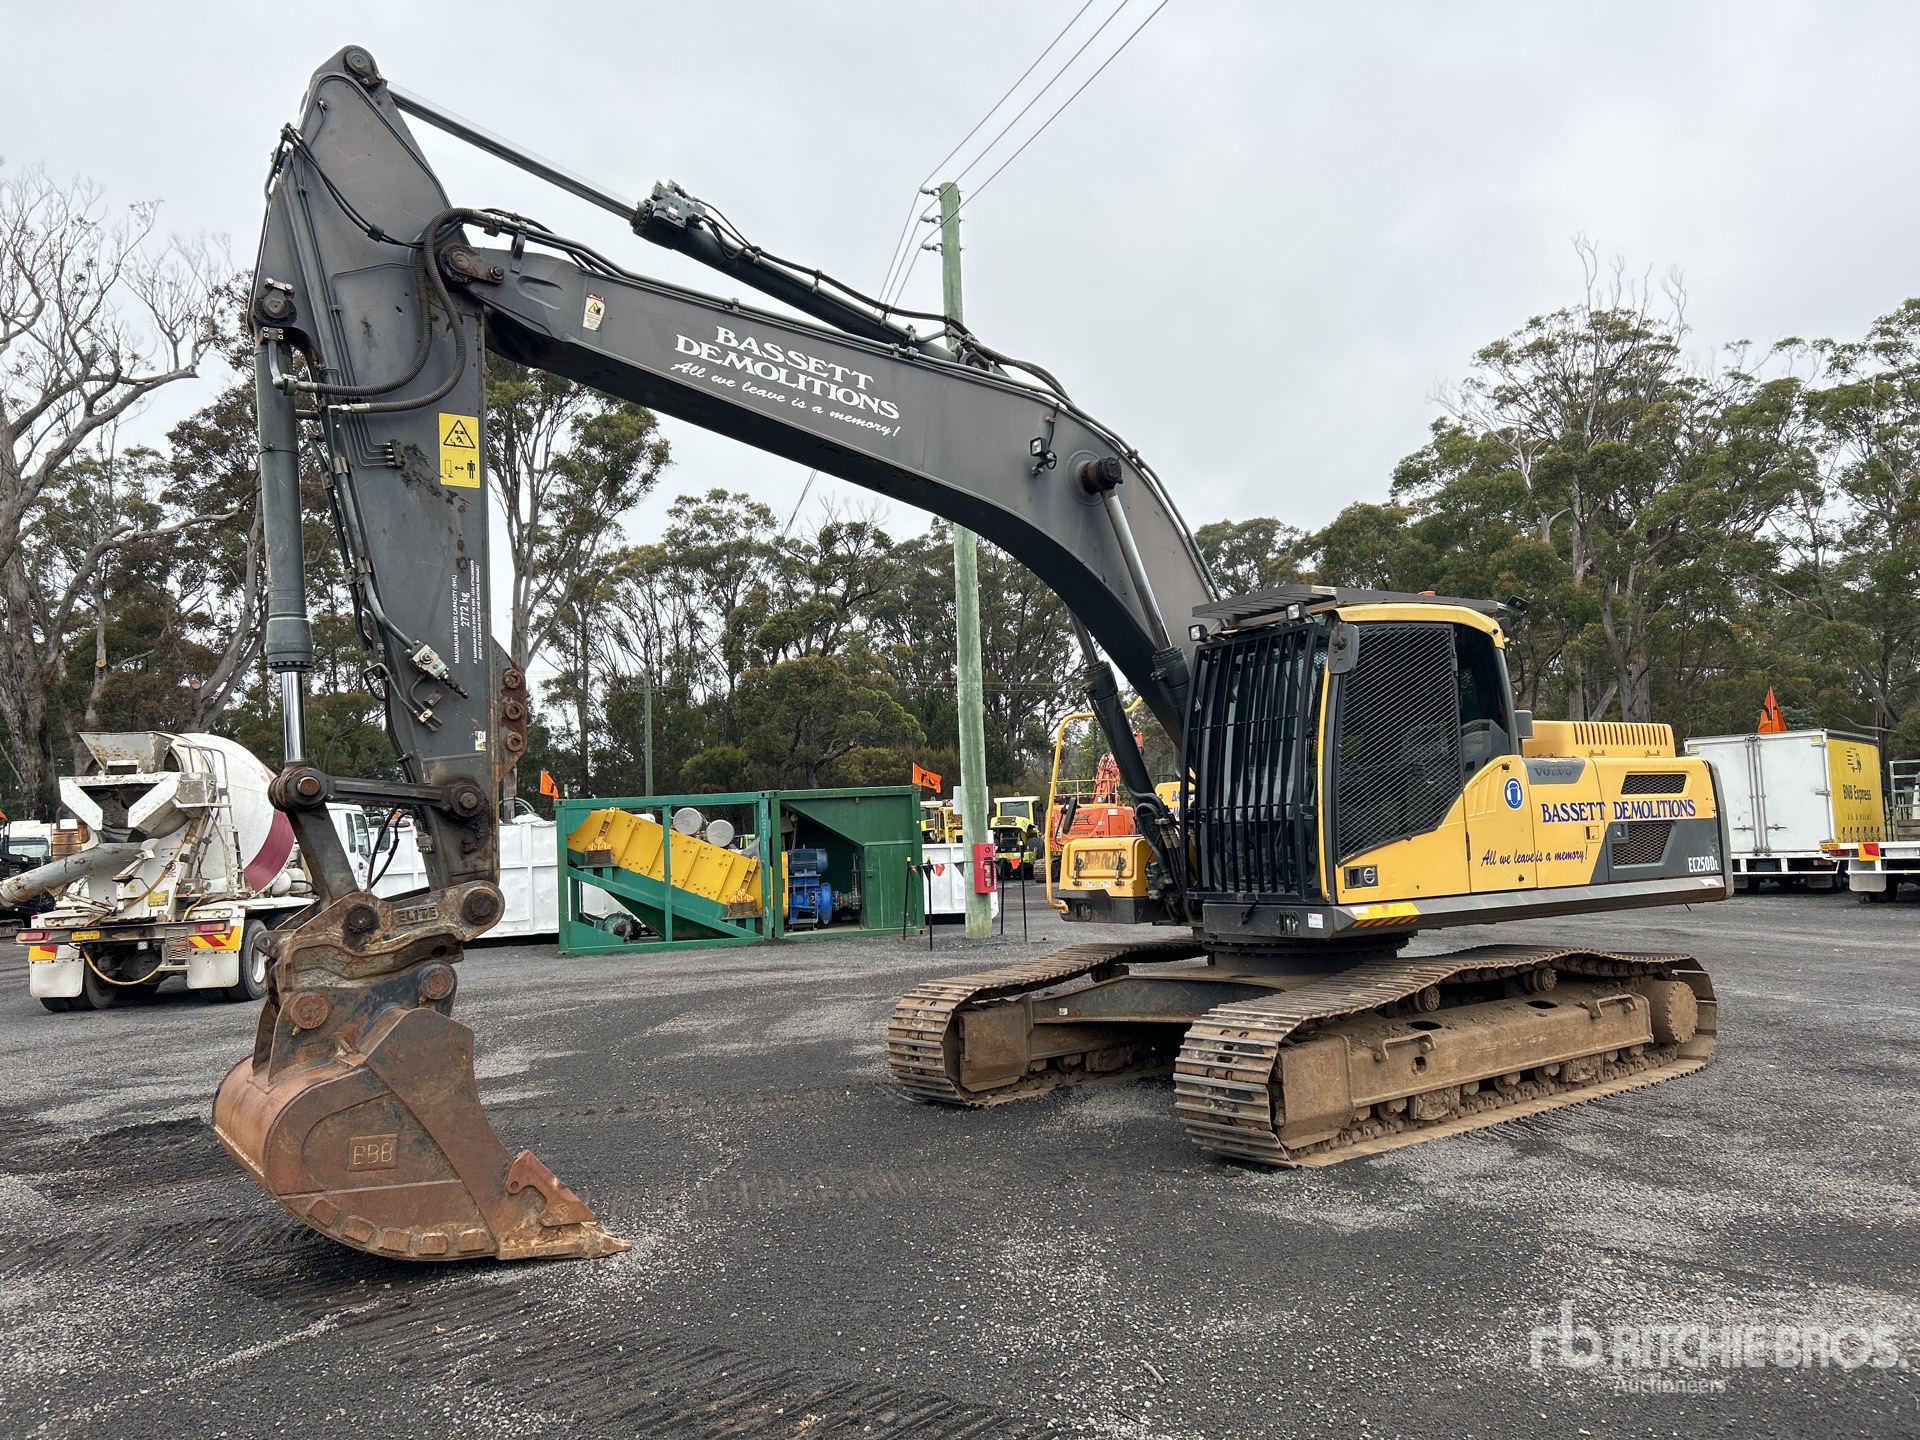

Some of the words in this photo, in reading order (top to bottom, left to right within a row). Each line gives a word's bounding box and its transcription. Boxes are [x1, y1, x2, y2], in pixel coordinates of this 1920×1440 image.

[715, 326, 874, 391] BASSETT
[675, 334, 900, 420] DEMOLITIONS
[670, 362, 705, 378] All
[711, 375, 736, 387] we
[741, 379, 786, 403] leave
[791, 396, 807, 409] is
[812, 405, 823, 414] a
[829, 409, 901, 437] memory!
[459, 592, 470, 603] kg
[460, 606, 470, 627] 2772
[1533, 767, 1572, 776] VOLVO
[1541, 801, 1606, 823] BASSETT
[1613, 799, 1697, 819] DEMOLITIONS
[1480, 849, 1497, 867] All
[1499, 854, 1511, 865] we
[1513, 849, 1534, 864] leave
[1535, 850, 1543, 863] is
[1545, 852, 1551, 861] a
[1554, 845, 1588, 863] memory!
[397, 906, 438, 922] ELITE
